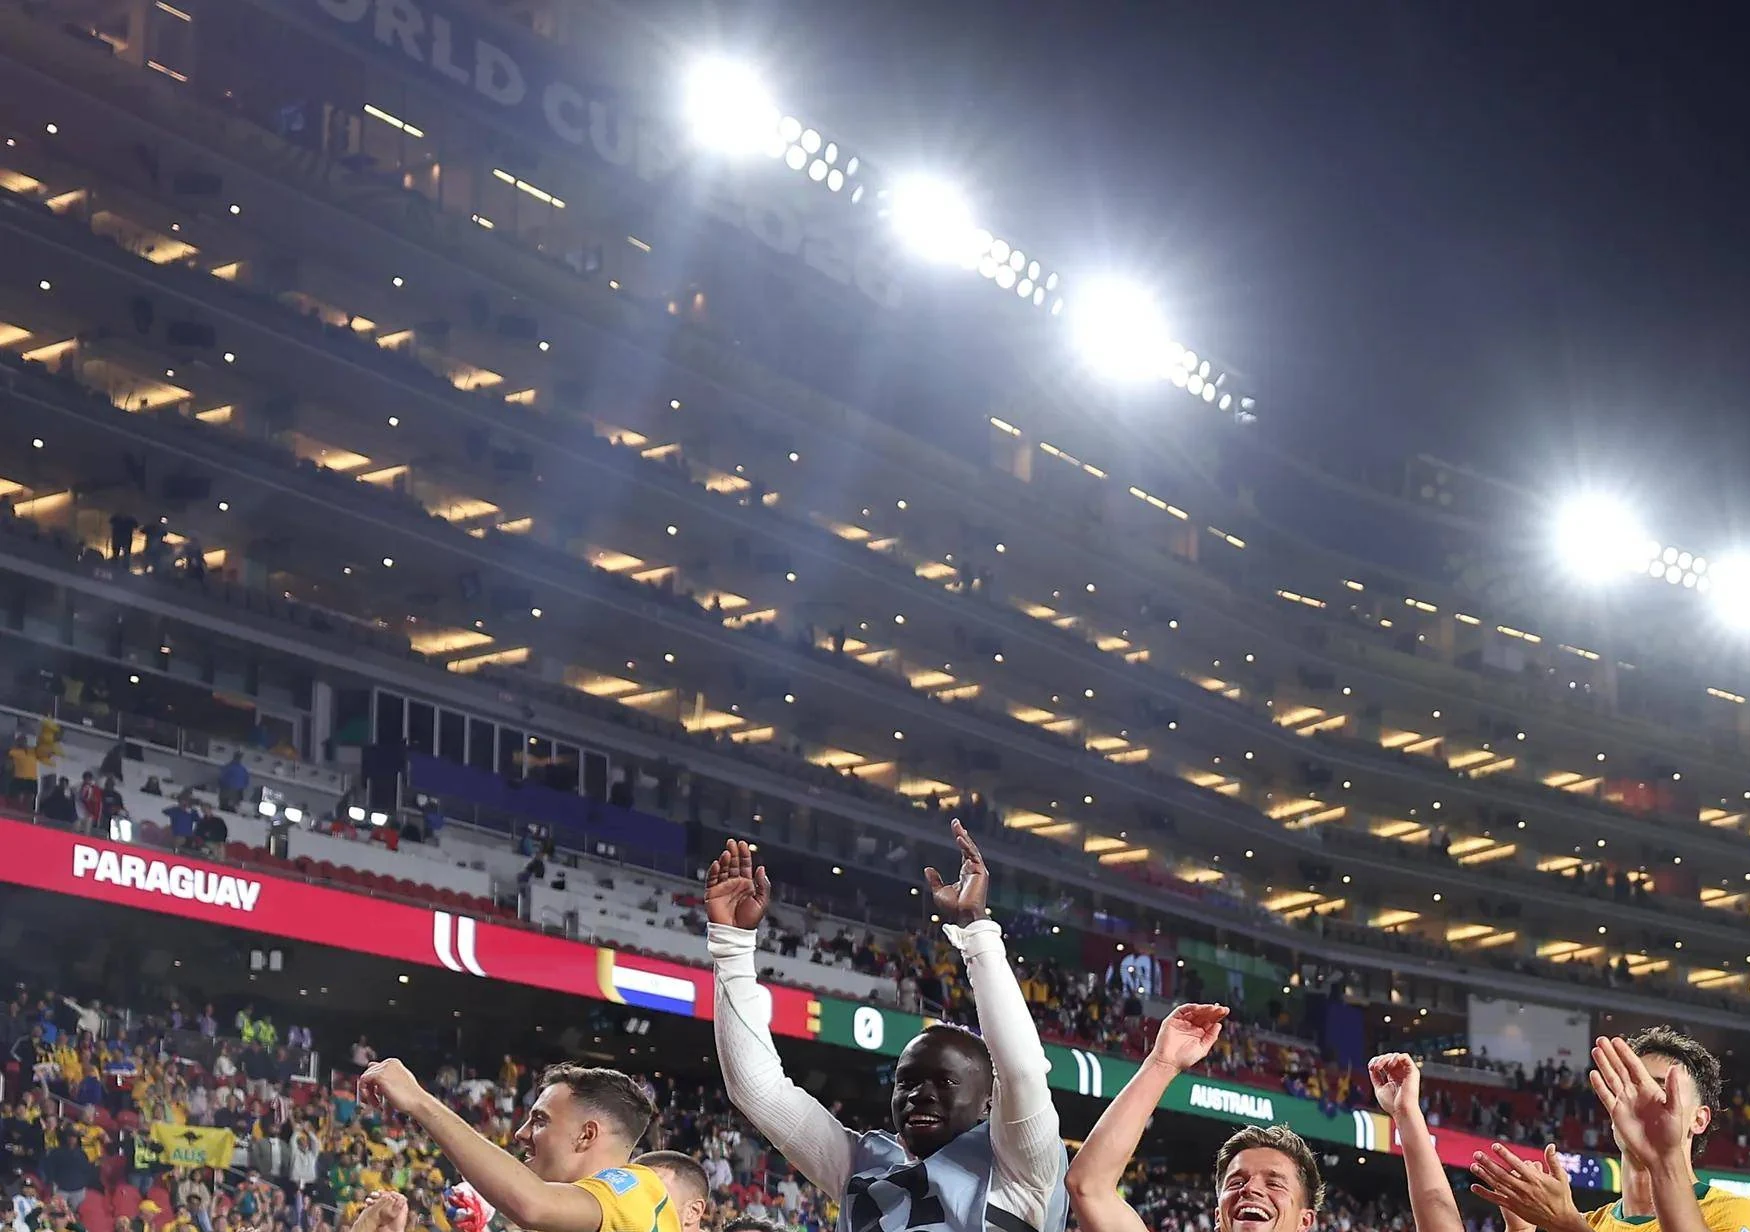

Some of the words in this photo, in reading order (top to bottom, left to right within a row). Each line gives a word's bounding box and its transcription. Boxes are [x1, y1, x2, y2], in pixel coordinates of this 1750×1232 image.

[73, 844, 261, 912] PARAGUAY
[853, 1006, 884, 1050] 0
[1189, 1084, 1274, 1121] AUSTRALIA
